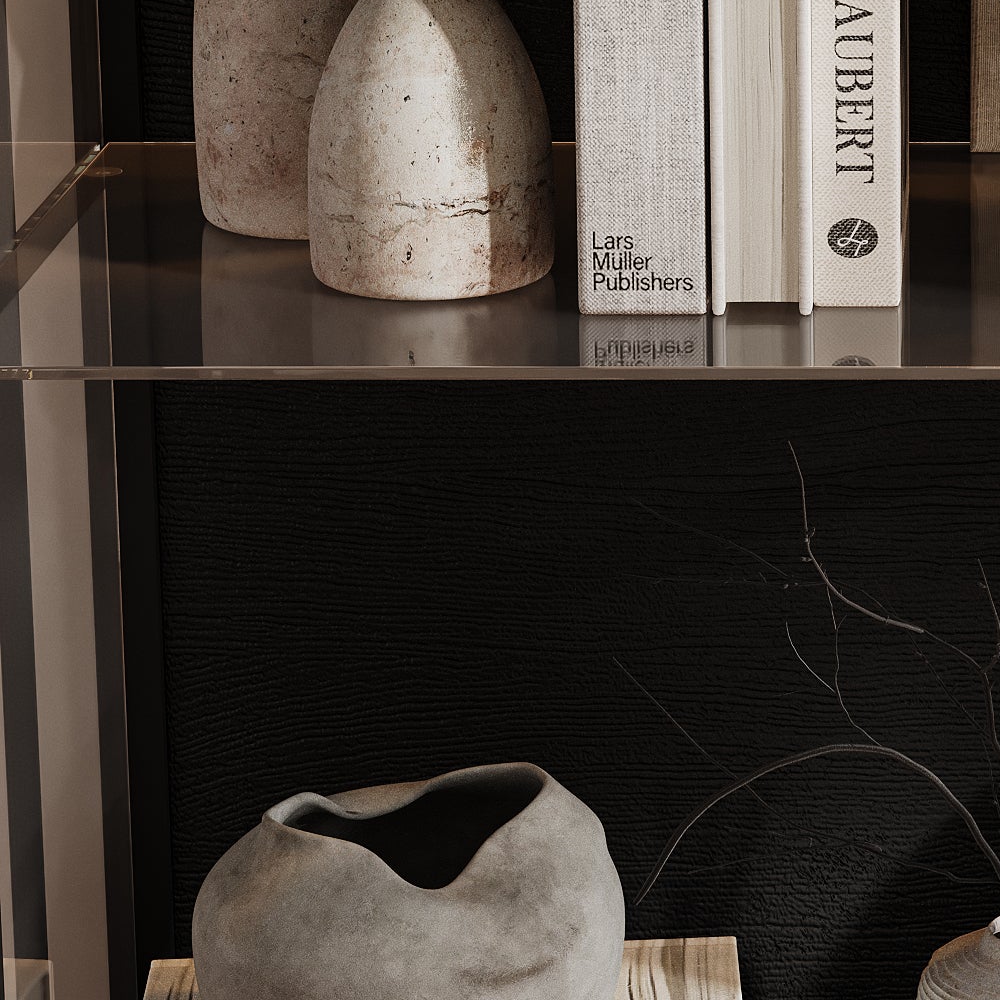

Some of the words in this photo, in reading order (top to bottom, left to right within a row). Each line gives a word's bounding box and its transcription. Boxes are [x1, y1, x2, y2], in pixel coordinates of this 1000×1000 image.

[592, 231, 634, 250] Lars
[592, 252, 652, 270] Müller
[593, 272, 694, 292] Publishers
